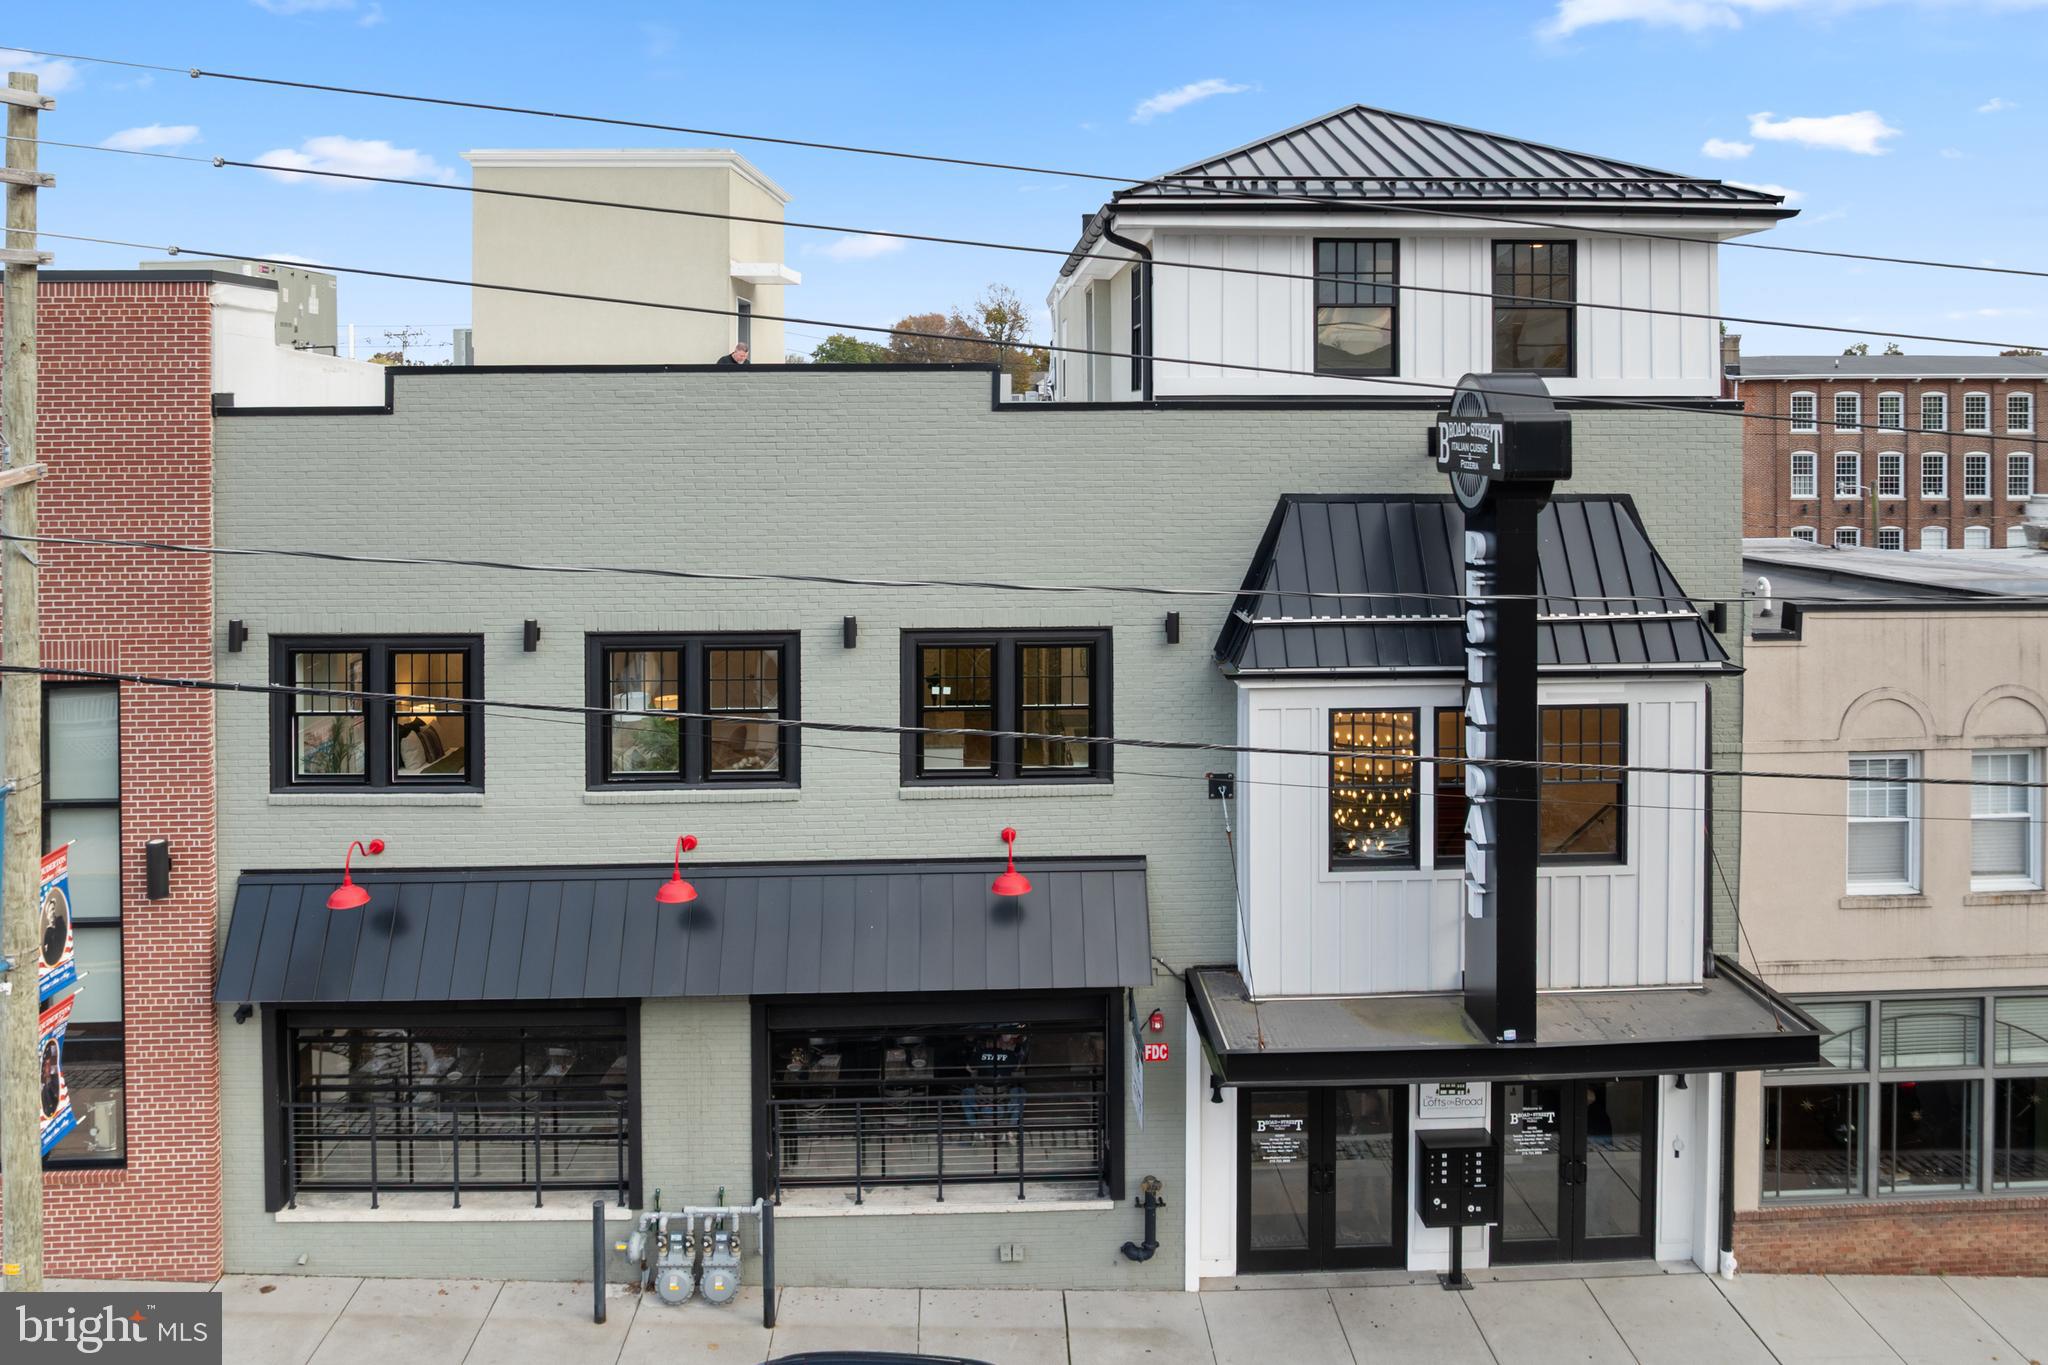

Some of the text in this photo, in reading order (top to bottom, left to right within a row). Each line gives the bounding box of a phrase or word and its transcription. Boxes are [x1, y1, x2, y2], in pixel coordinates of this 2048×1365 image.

[1451, 442, 1488, 454] ITALIAN CUISINE
[1464, 531, 1487, 918] RESTAURANT
[1144, 1044, 1168, 1060] FDC
[1423, 1097, 1446, 1107] Lofts
[1455, 1097, 1483, 1106] Broad
